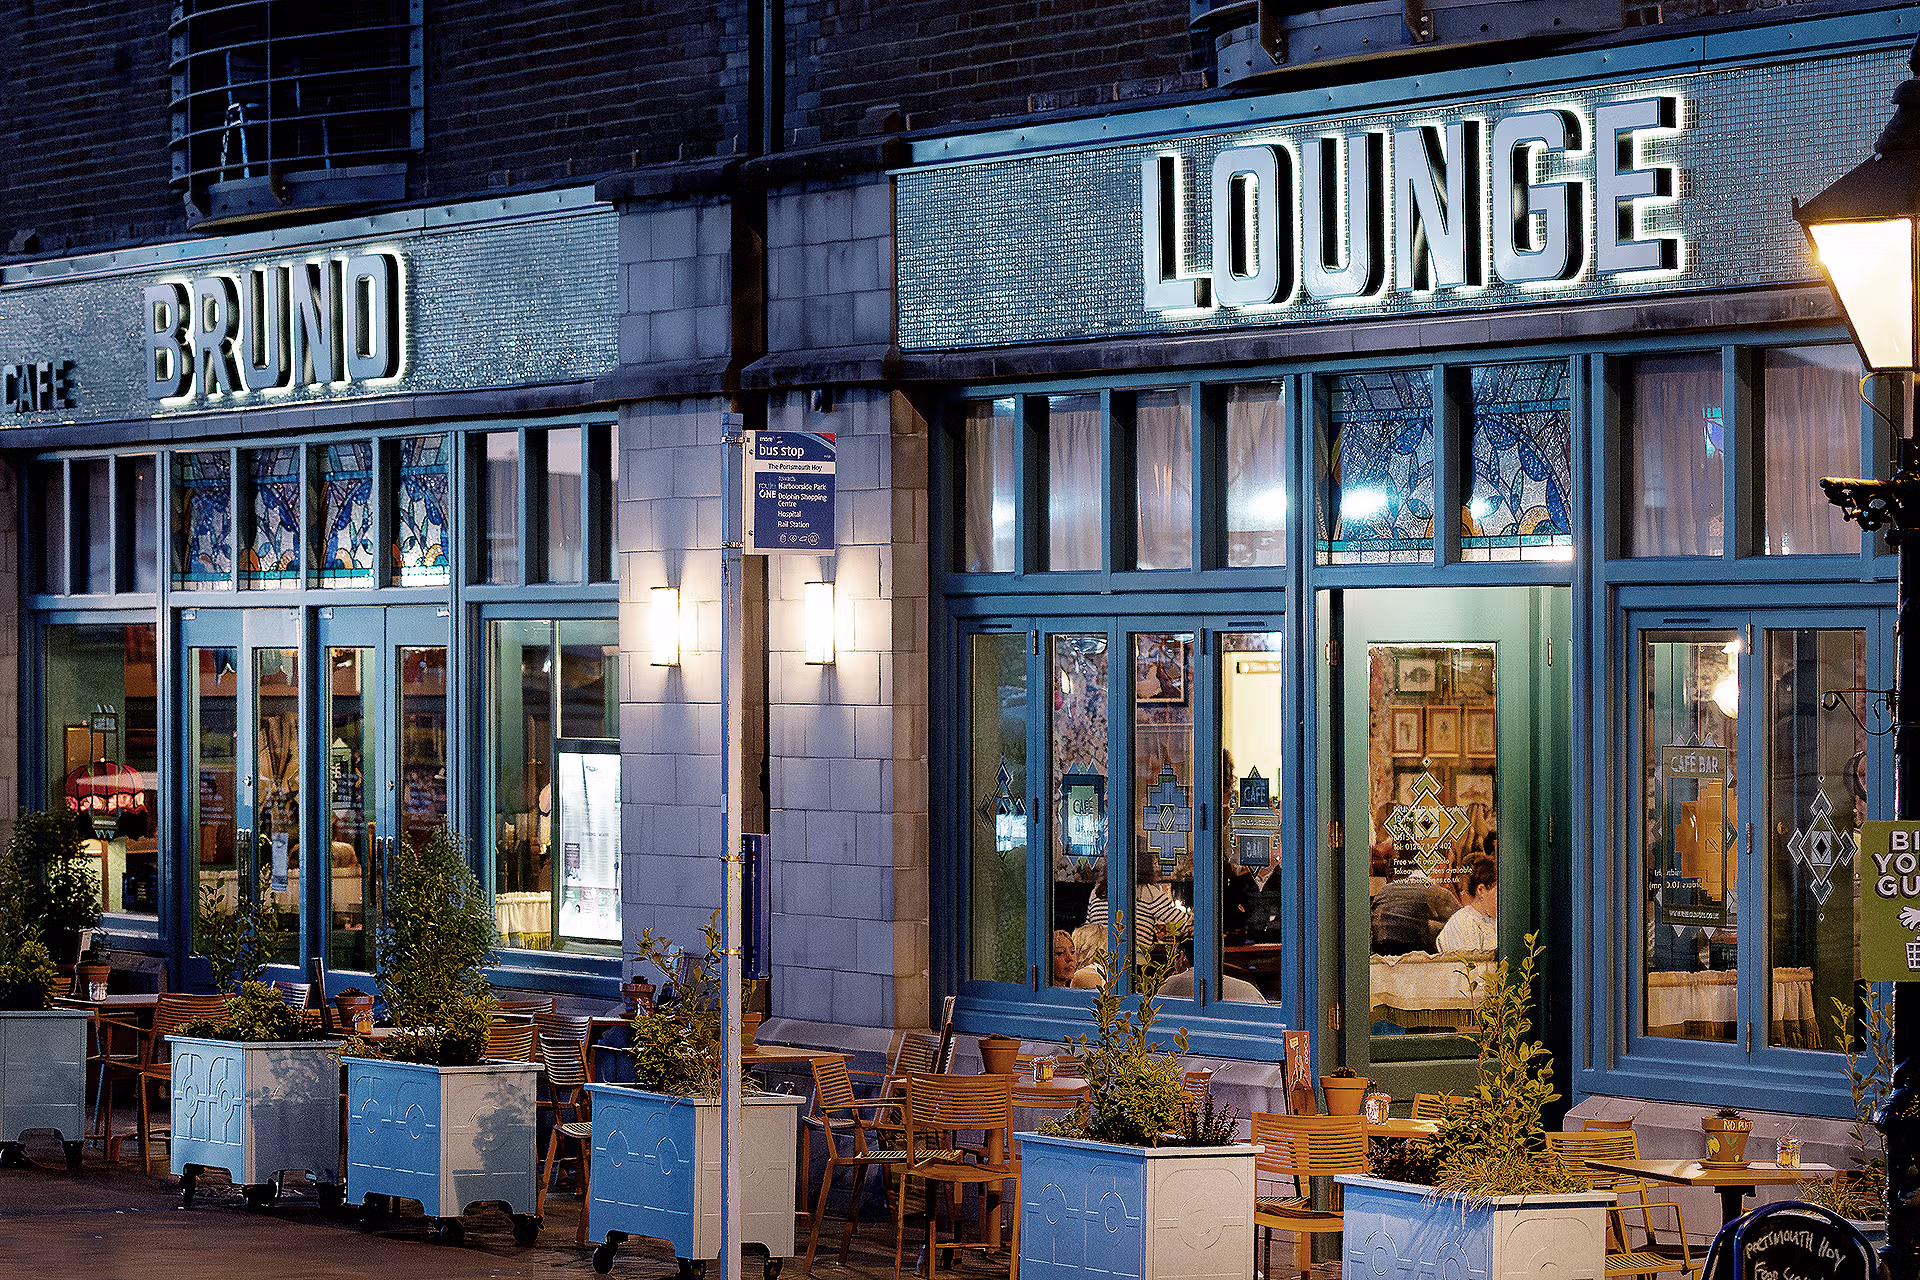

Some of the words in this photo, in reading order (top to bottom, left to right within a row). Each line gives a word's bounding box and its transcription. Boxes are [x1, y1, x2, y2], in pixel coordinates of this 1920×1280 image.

[1141, 96, 1681, 312] LOUNGE
[144, 252, 402, 402] BRUNO
[759, 444, 779, 457] bus
[781, 446, 805, 459] stop
[811, 464, 823, 472] Hoy
[813, 483, 827, 491] Park
[758, 490, 777, 499] ONE
[778, 493, 800, 501] Dolphin
[801, 494, 828, 503] Shopping
[777, 511, 802, 519] Hospital
[777, 520, 789, 528] Rail
[1699, 755, 1719, 773] BAR
